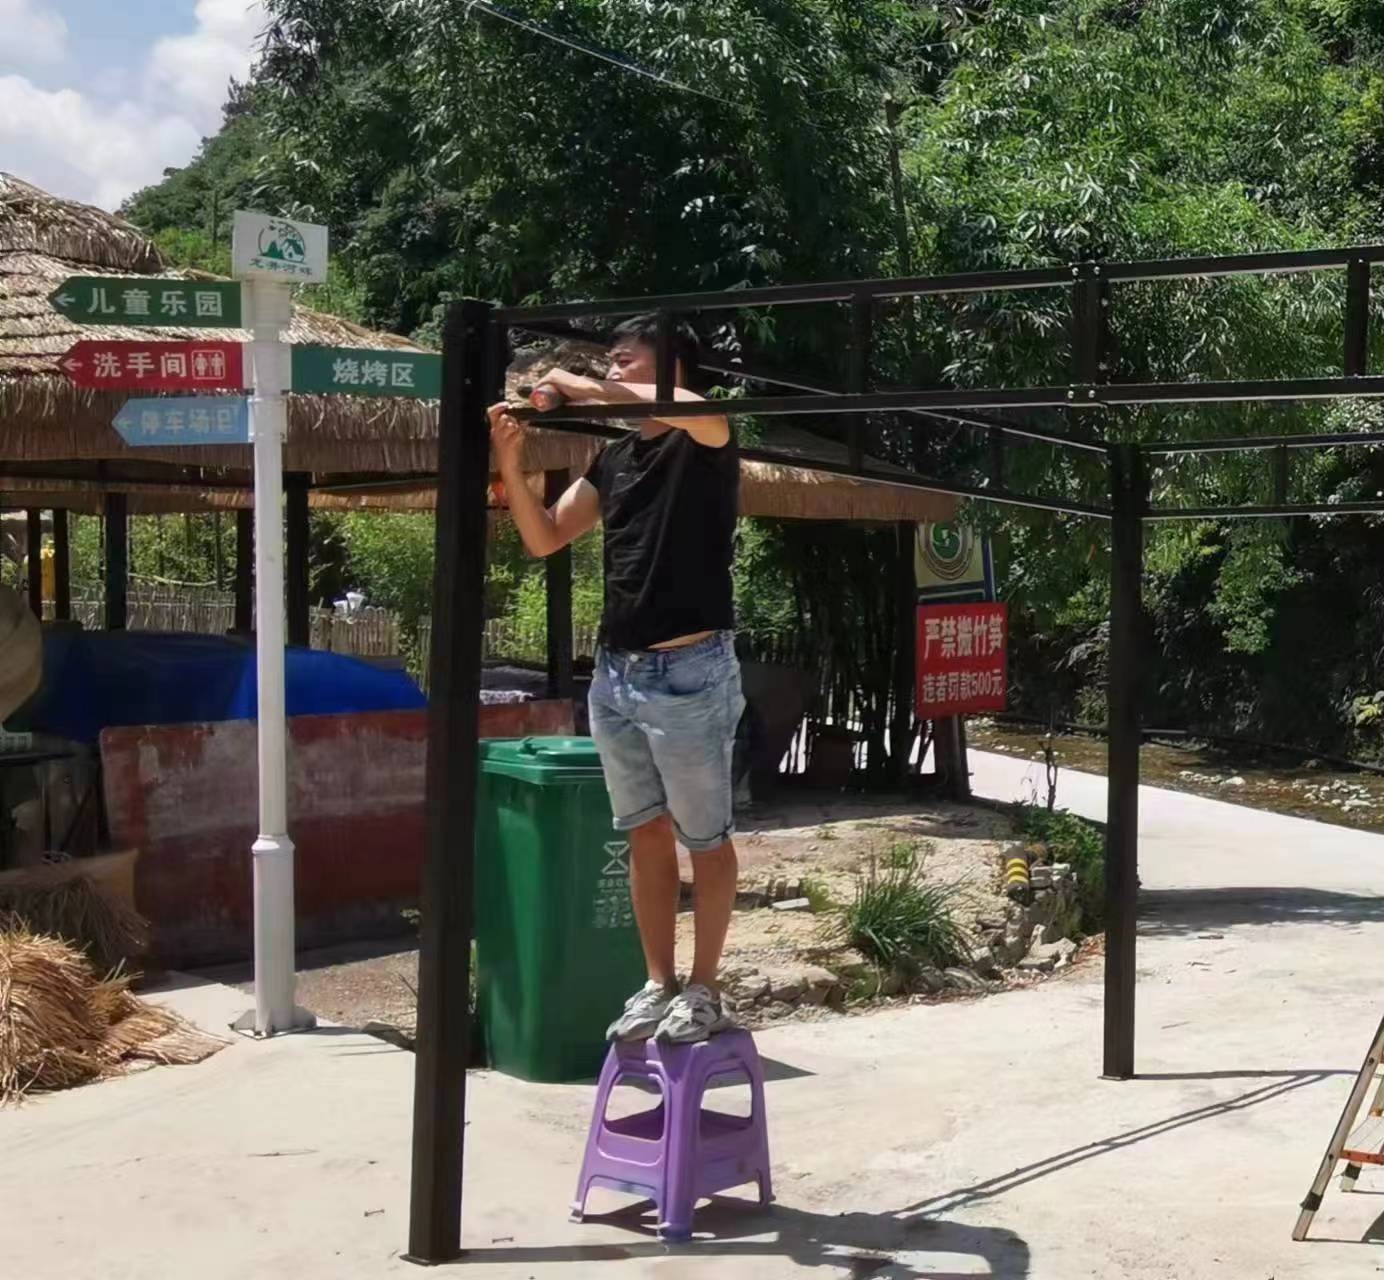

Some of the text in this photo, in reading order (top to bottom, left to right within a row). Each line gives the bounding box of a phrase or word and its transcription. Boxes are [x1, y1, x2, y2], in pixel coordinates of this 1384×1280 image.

[86, 288, 224, 317] 儿童乐园
[94, 351, 187, 378] 洗手间
[332, 357, 415, 388] 烧烤区
